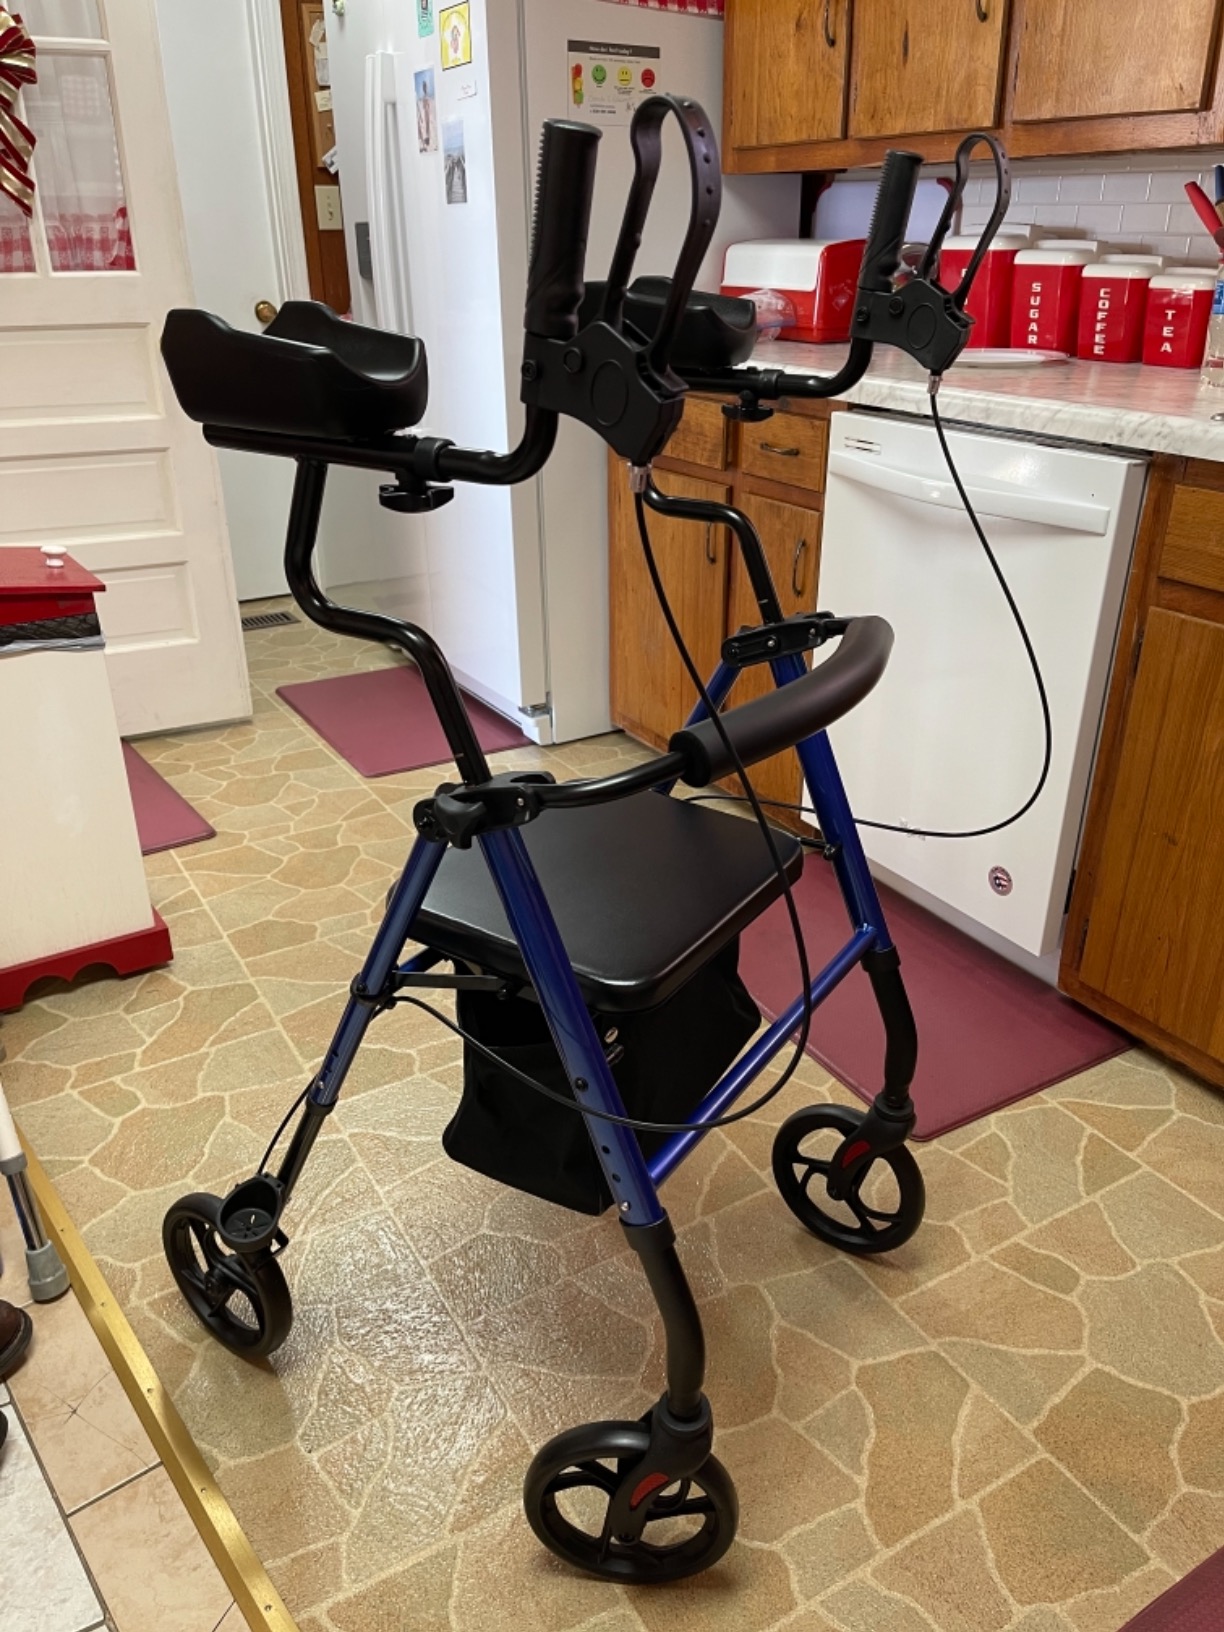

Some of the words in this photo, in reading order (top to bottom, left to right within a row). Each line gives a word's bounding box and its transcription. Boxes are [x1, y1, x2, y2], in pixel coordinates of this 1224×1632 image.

[1027, 282, 1042, 345] SUGAR
[1093, 288, 1111, 355] COFFEE
[1160, 310, 1176, 353] TEA
